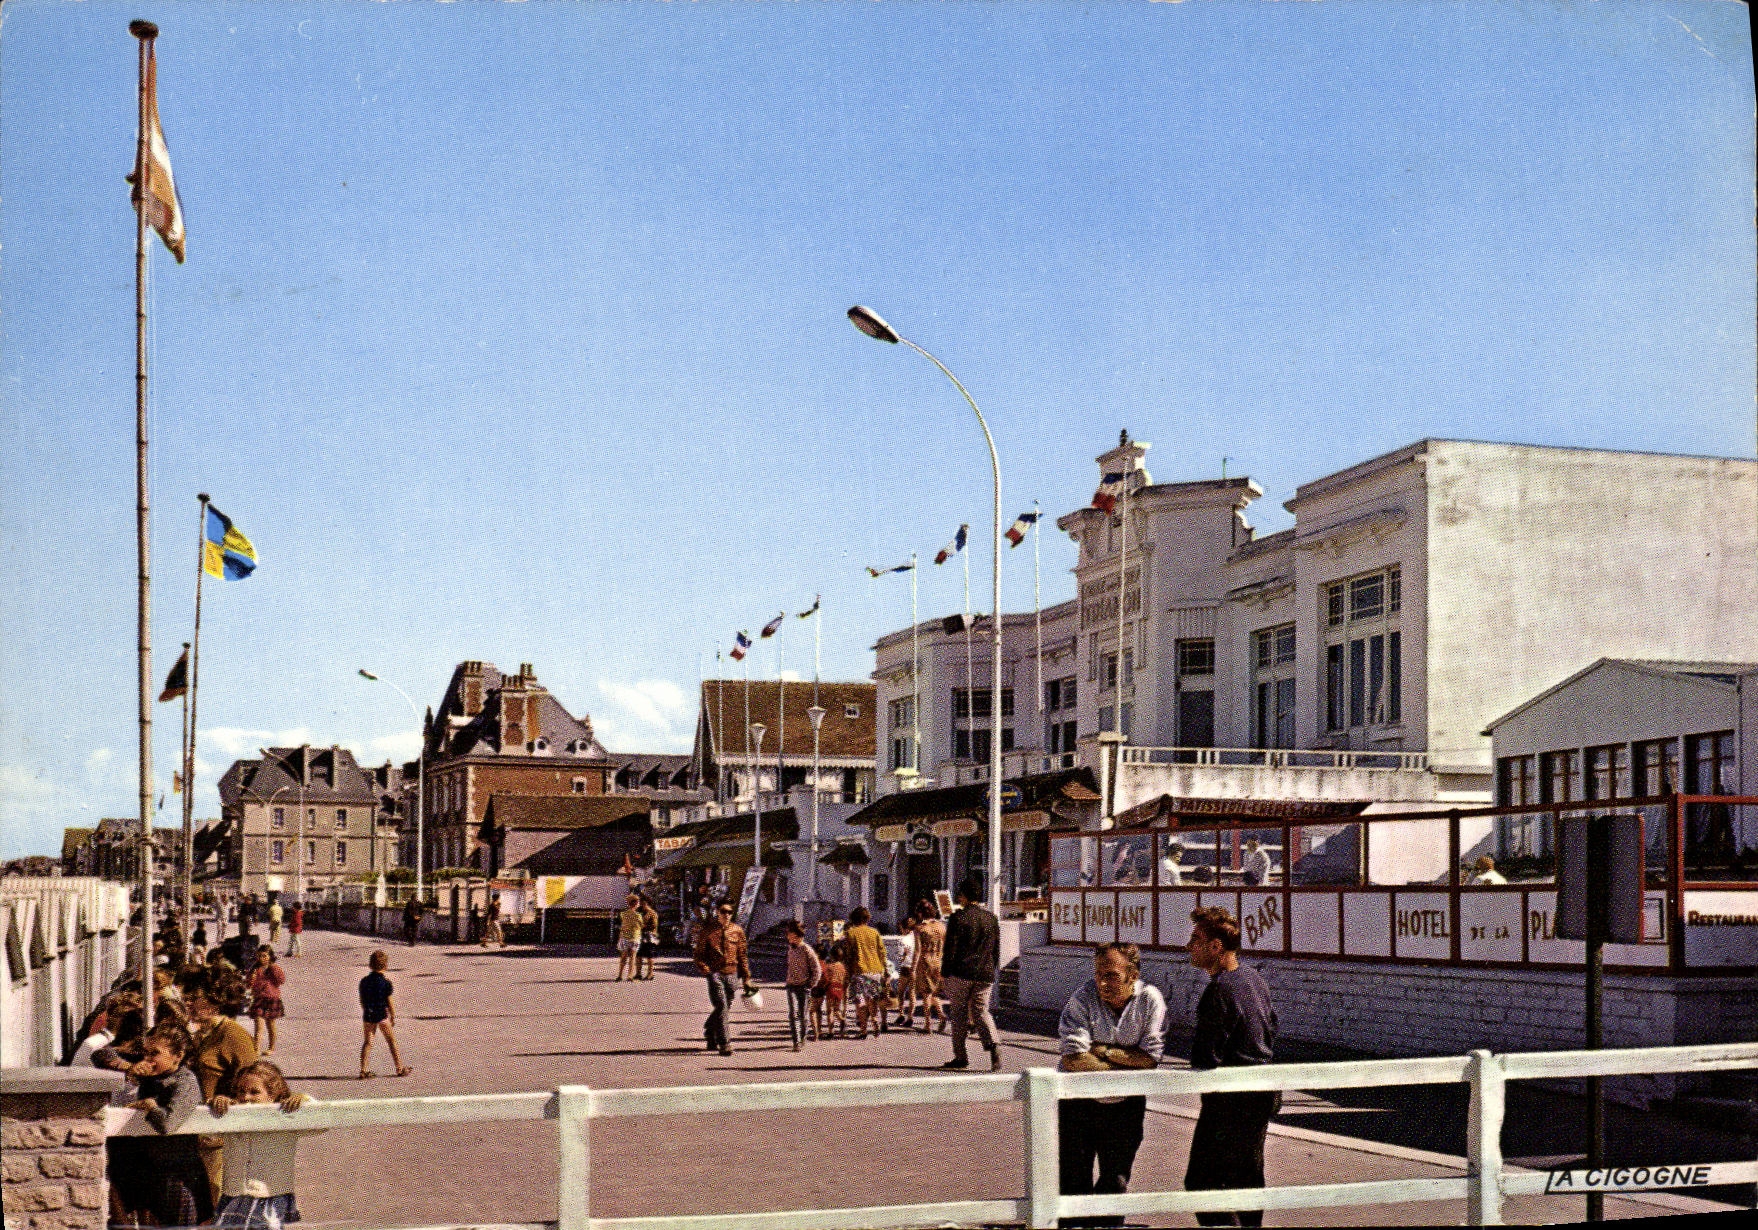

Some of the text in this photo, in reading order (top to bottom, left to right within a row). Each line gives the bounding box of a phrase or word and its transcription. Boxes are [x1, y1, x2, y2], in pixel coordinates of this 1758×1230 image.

[1244, 896, 1282, 945] BAR
[1397, 909, 1449, 938] HOTEL
[1494, 926, 1510, 940] LA
[1530, 910, 1556, 940] PL
